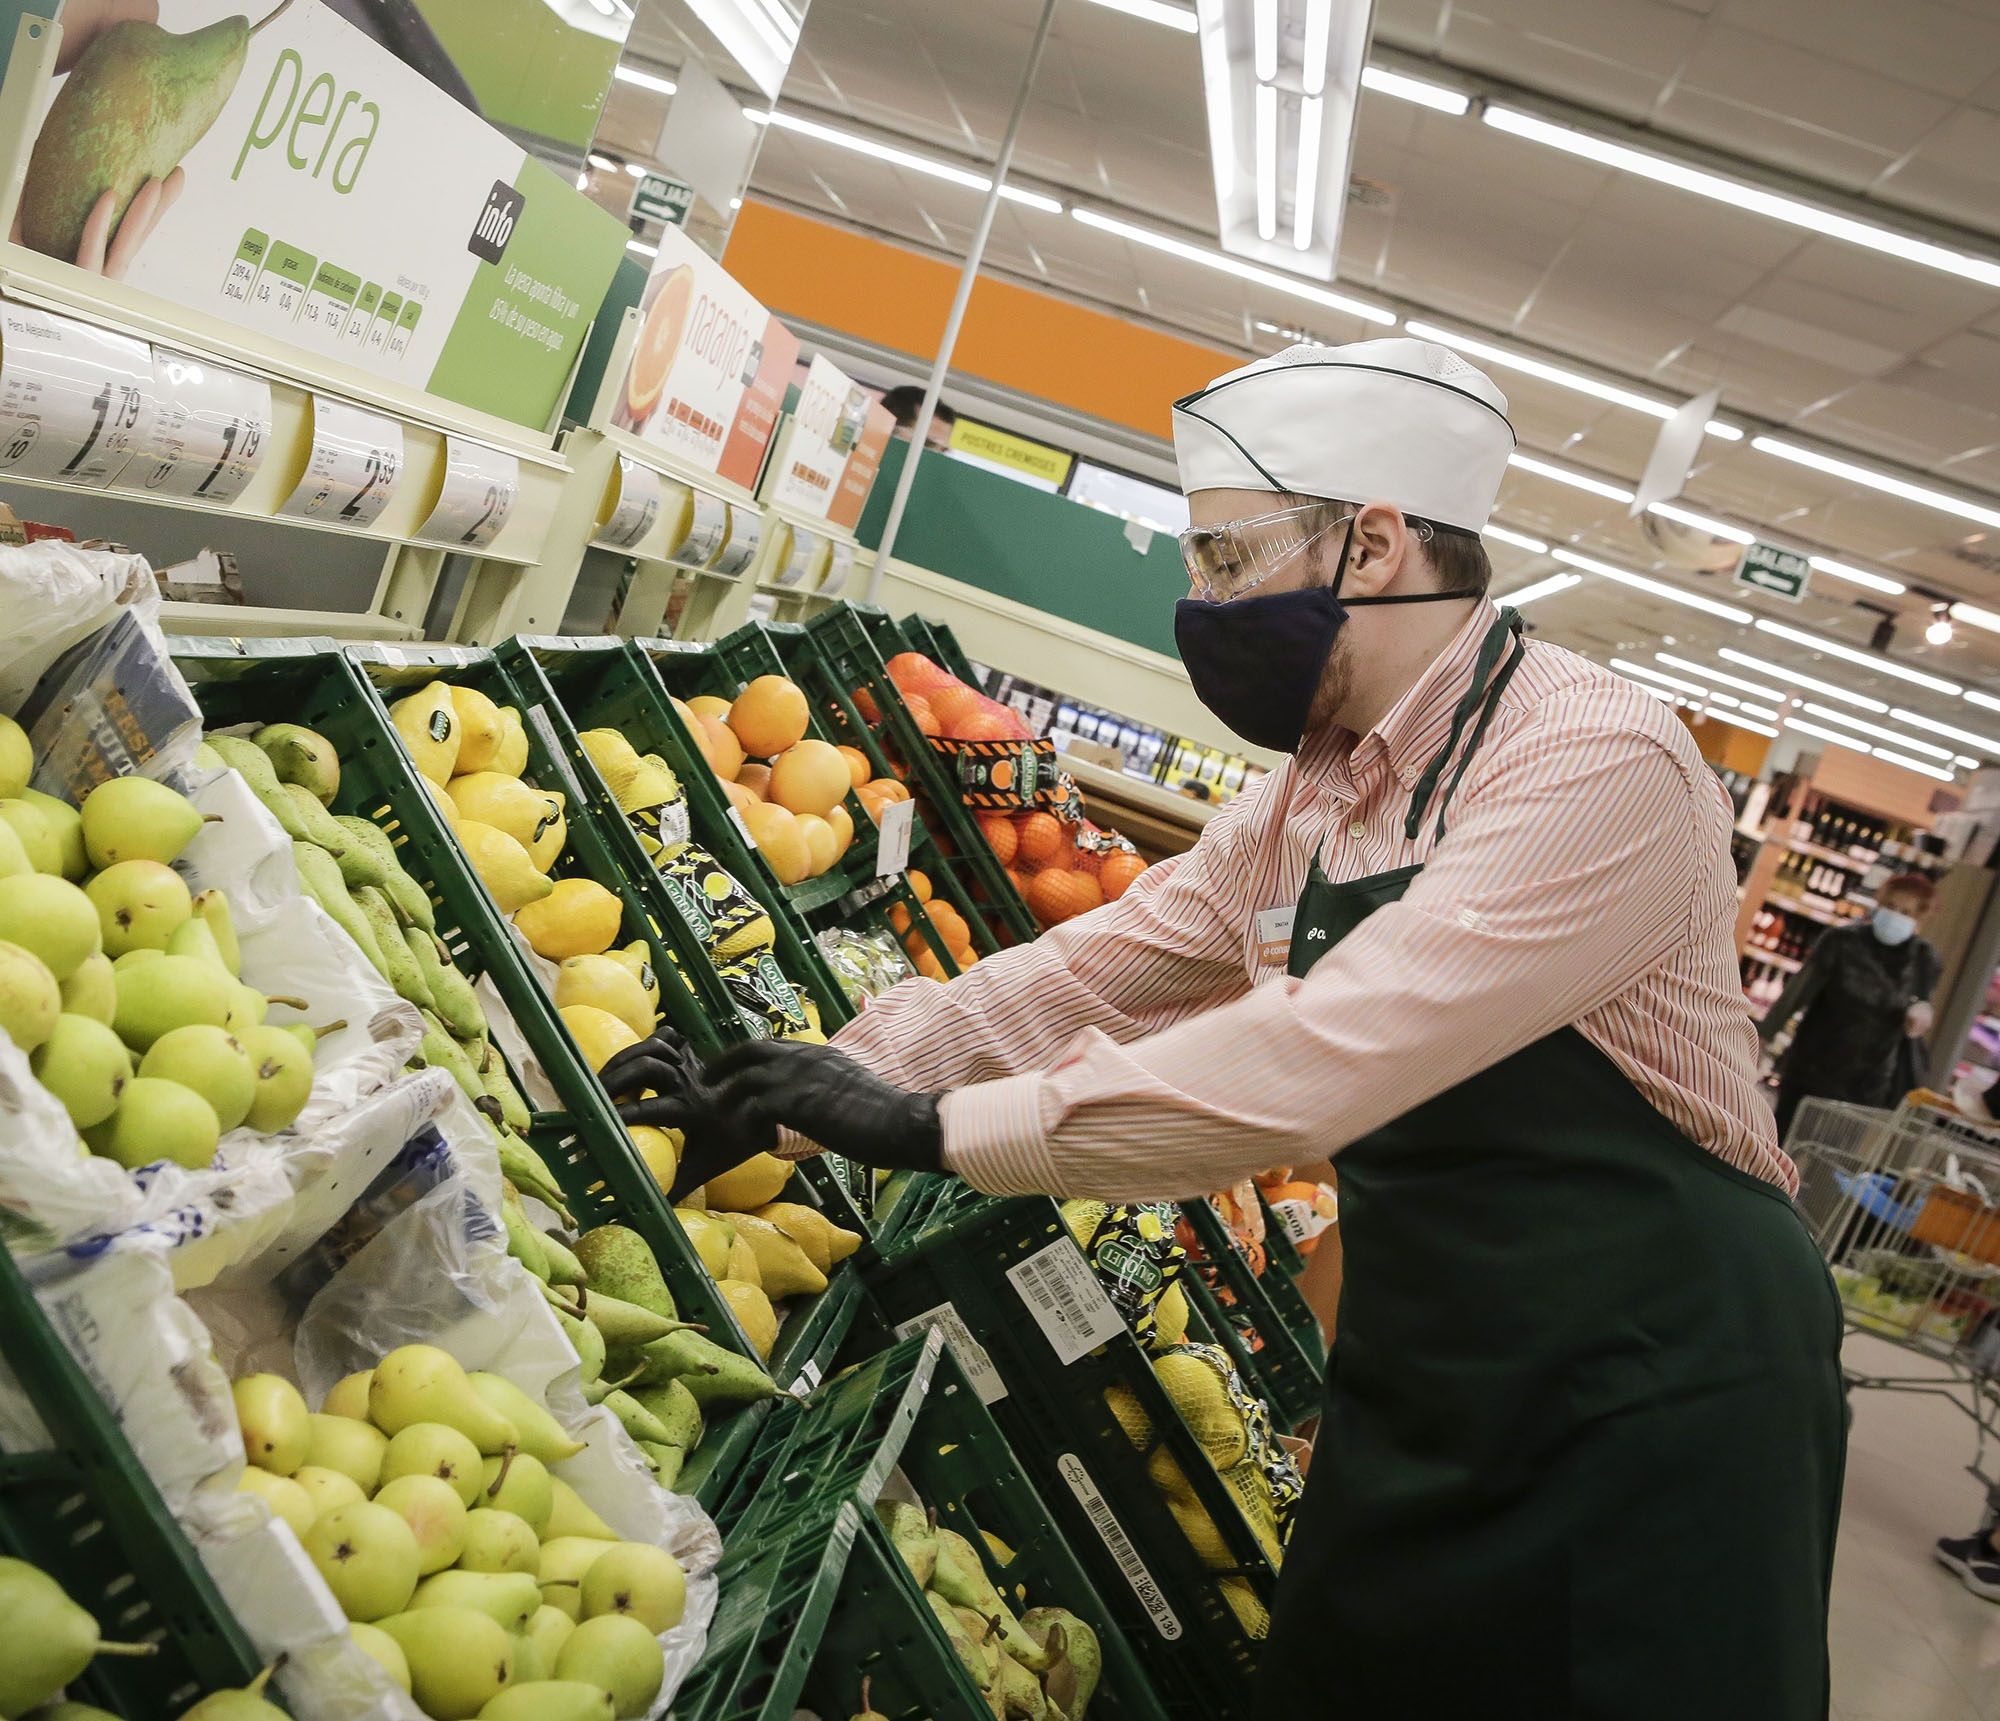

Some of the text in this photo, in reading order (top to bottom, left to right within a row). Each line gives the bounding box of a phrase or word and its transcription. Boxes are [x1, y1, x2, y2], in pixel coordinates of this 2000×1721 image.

[231, 48, 380, 194] pera
[476, 192, 514, 248] info
[504, 263, 517, 285] La
[685, 293, 748, 391] naranja
[4, 440, 30, 459] 10
[63, 382, 112, 471] 1
[115, 385, 141, 429] 79
[339, 449, 381, 517] 2
[460, 486, 498, 541] 2
[1748, 545, 1808, 580] SALIDA
[761, 961, 803, 1016] BOUQUET
[1159, 1614, 1177, 1636] 136
